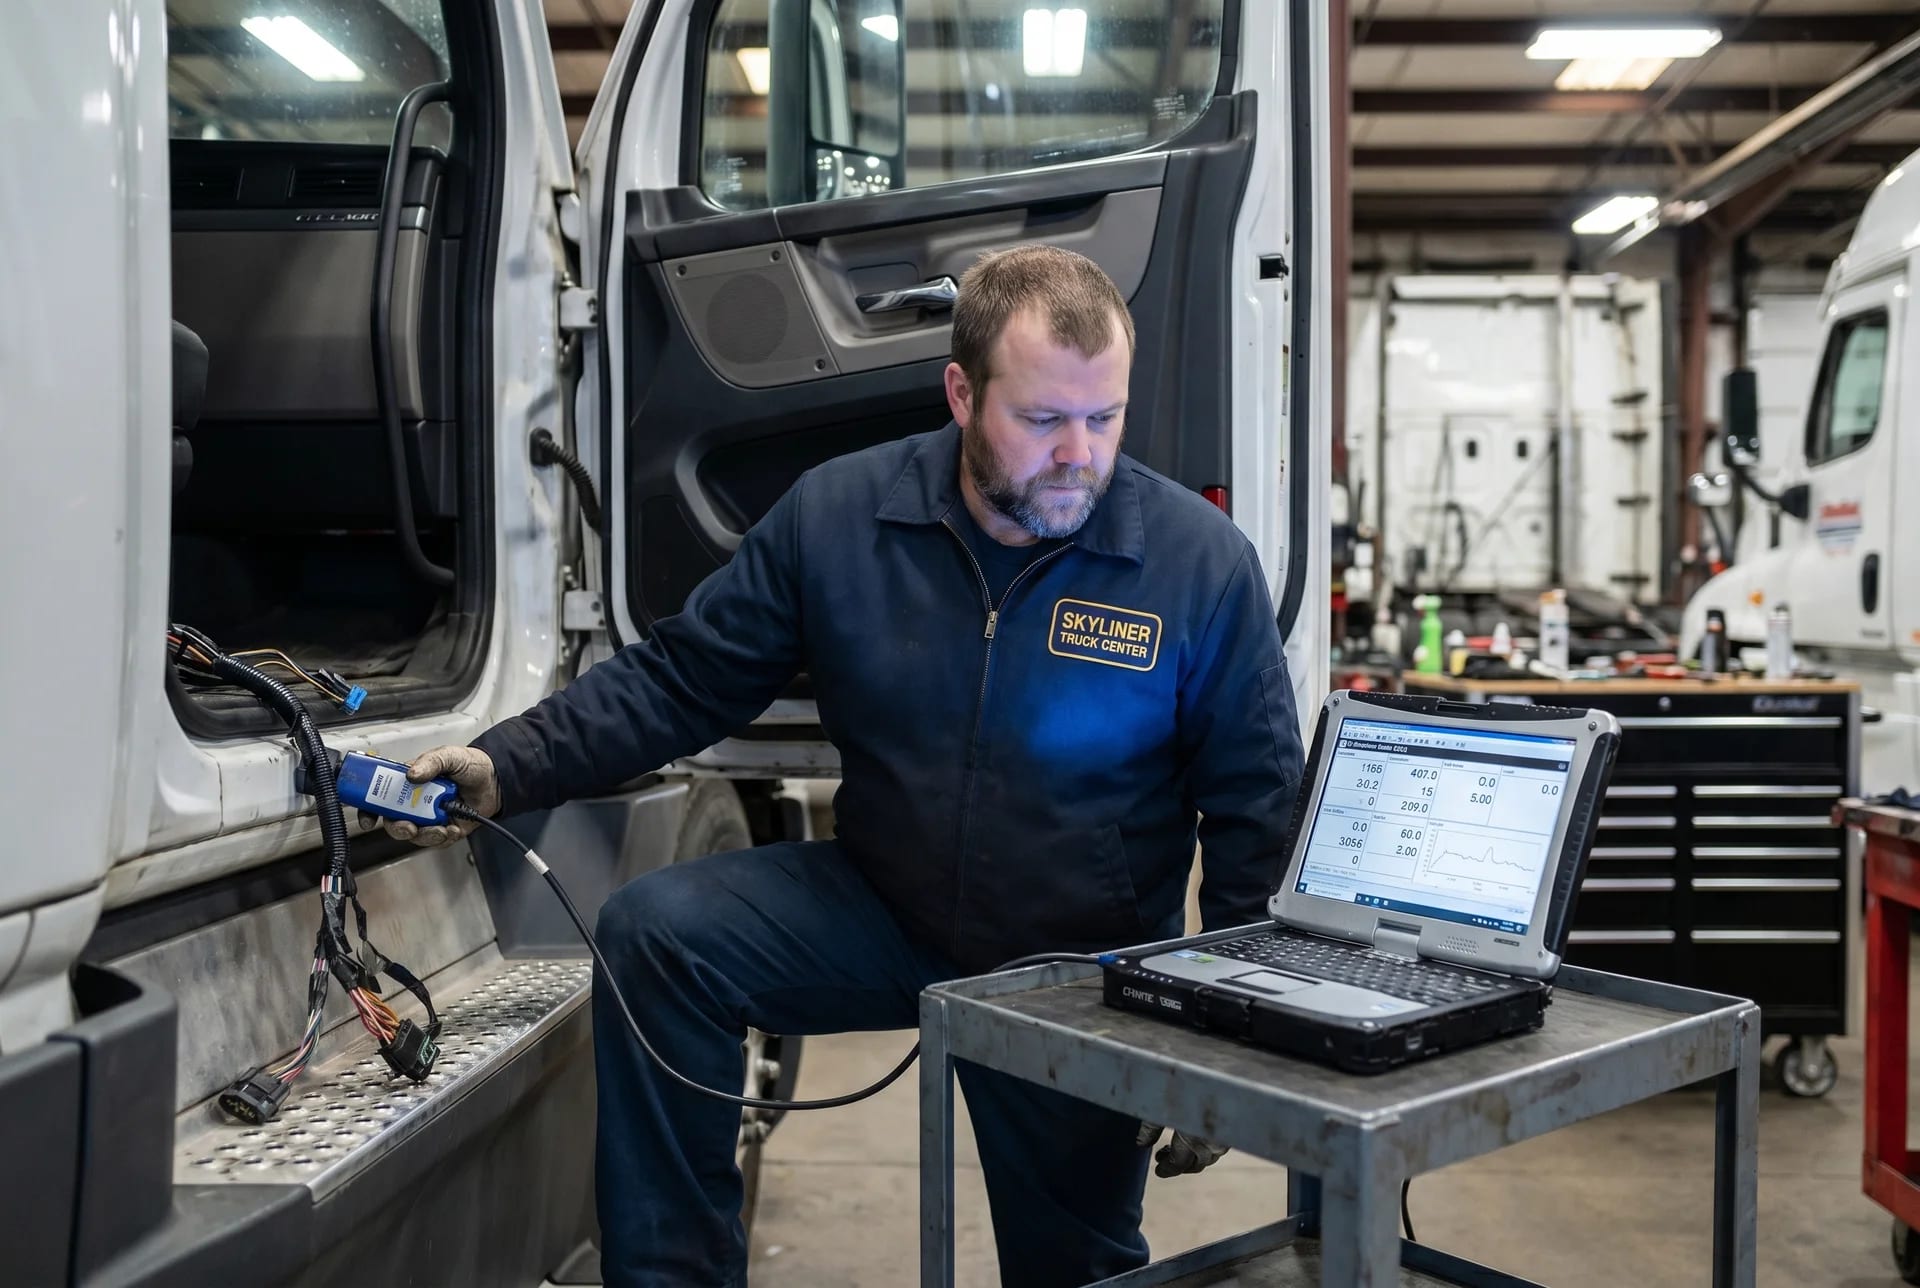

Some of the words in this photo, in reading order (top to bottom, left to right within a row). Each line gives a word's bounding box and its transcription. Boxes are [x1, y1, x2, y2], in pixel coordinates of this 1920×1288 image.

[1062, 611, 1151, 643] SKYLINER
[1060, 632, 1099, 649] TRUCK
[1101, 639, 1147, 658] CENTER
[1410, 768, 1438, 780] 407.0
[1478, 776, 1496, 788] 0.0
[1421, 786, 1434, 797] 15
[1541, 784, 1559, 796] 0.0
[1367, 796, 1374, 806] 0
[1470, 793, 1492, 805] 5.00
[1400, 801, 1428, 813] 209.0
[1352, 821, 1368, 832] 0.0
[1400, 828, 1422, 841] 60.0
[1338, 836, 1363, 849] 3056
[1396, 845, 1417, 857] 2.00
[1351, 855, 1359, 865] 0
